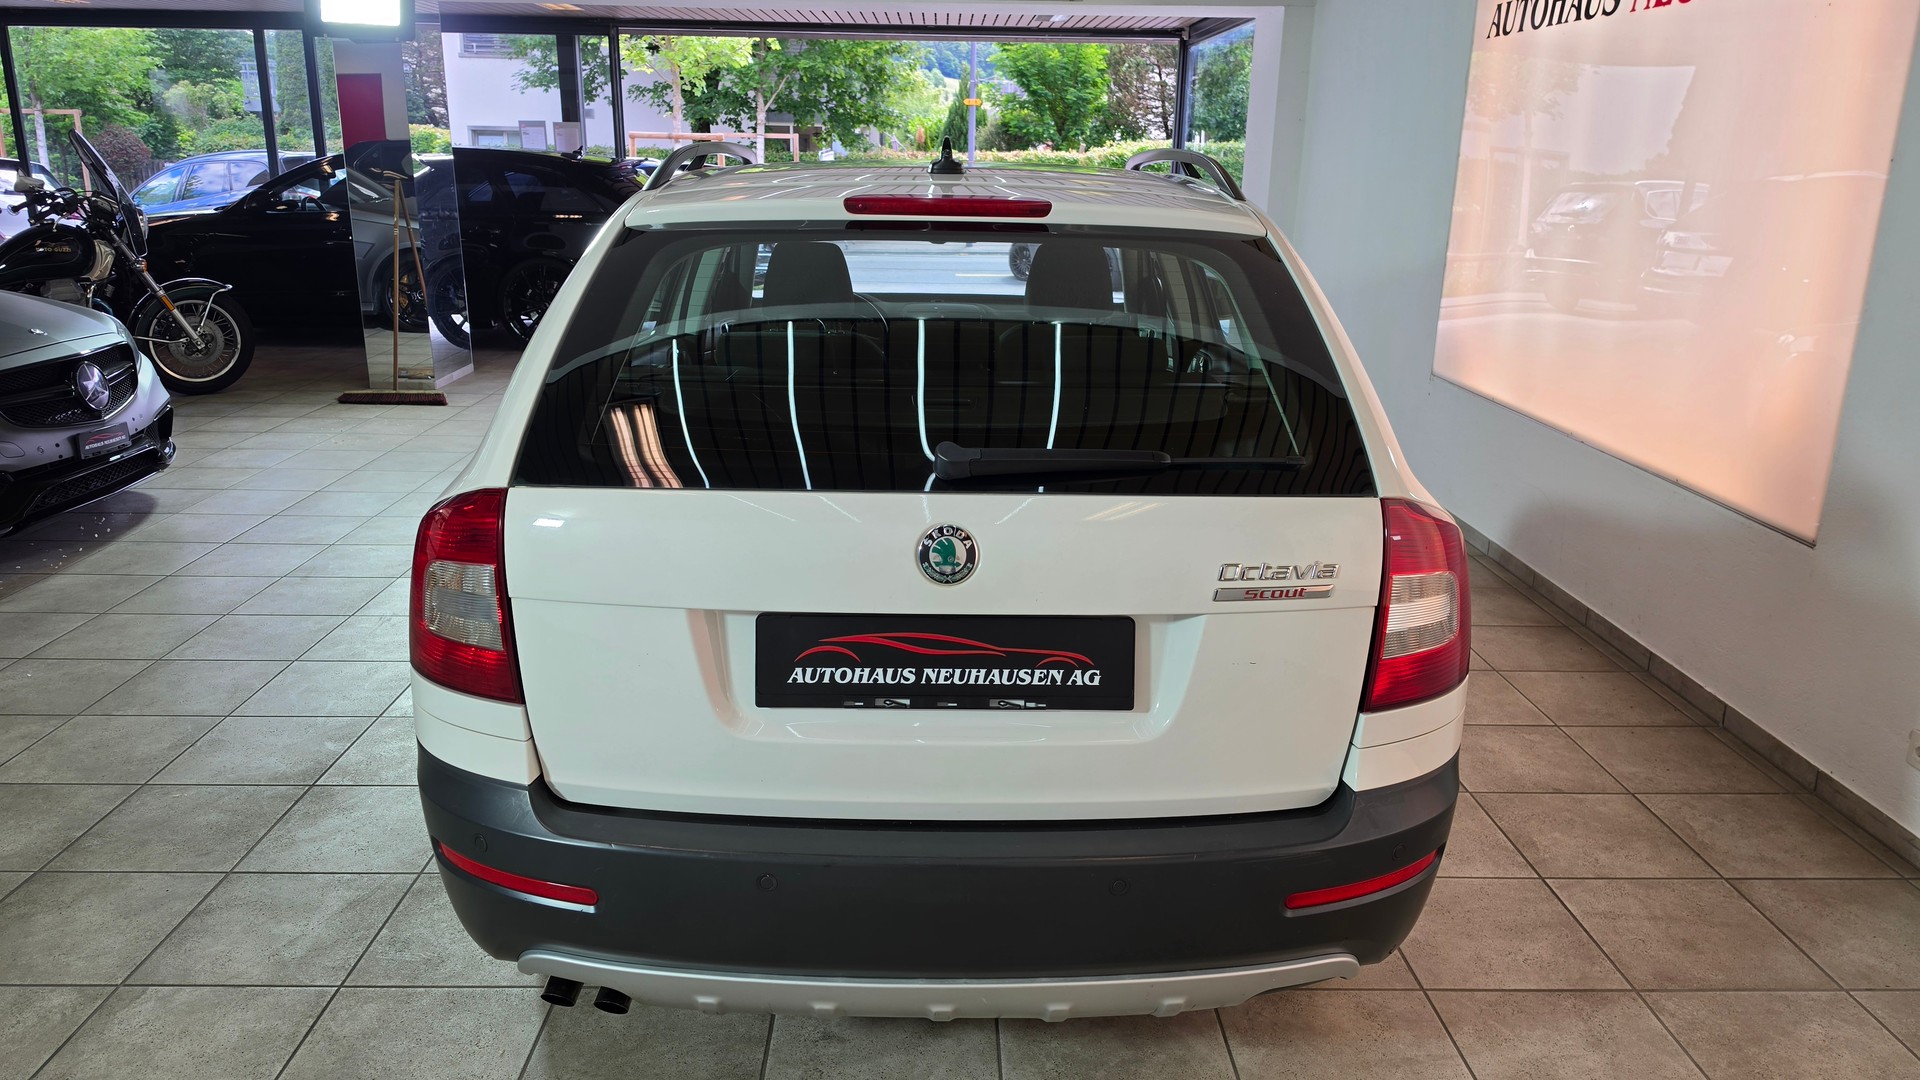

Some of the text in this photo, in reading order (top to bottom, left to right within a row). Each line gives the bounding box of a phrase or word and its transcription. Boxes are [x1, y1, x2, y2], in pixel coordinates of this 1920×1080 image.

[1218, 561, 1340, 581] Octavia
[787, 667, 1101, 686] AUTOHAUS NEUHAUSEN AG
